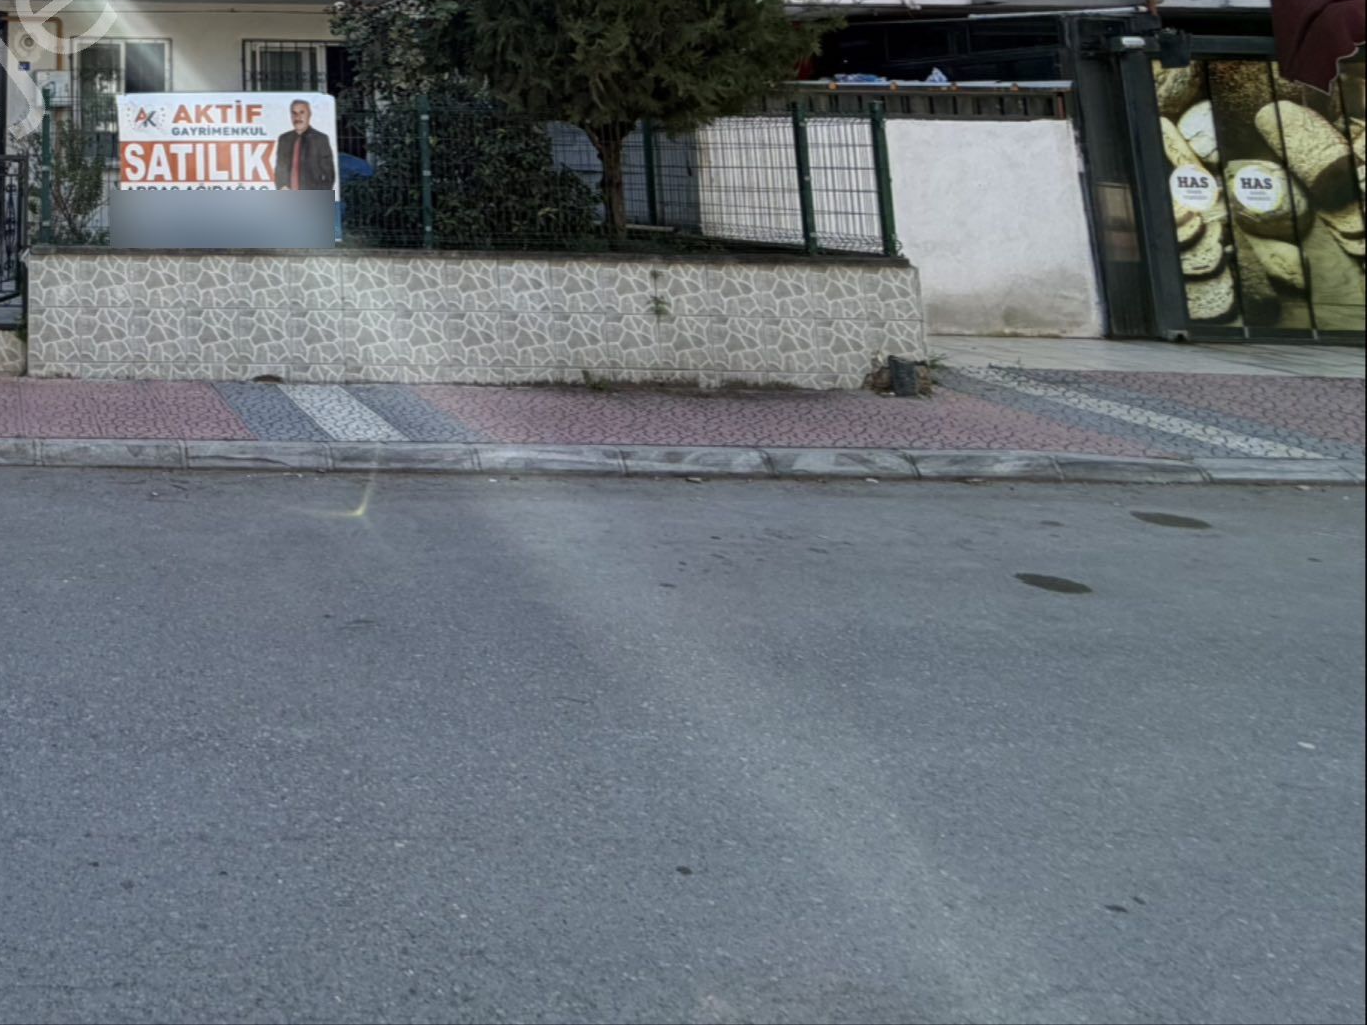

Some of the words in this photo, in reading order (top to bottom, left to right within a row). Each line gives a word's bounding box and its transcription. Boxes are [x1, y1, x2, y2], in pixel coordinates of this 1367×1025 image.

[172, 100, 263, 124] AKTİF
[171, 125, 267, 136] GAYRİMENKUL
[124, 143, 270, 181] SATILIK
[1177, 176, 1209, 188] HAS
[1240, 178, 1273, 190] HAS
